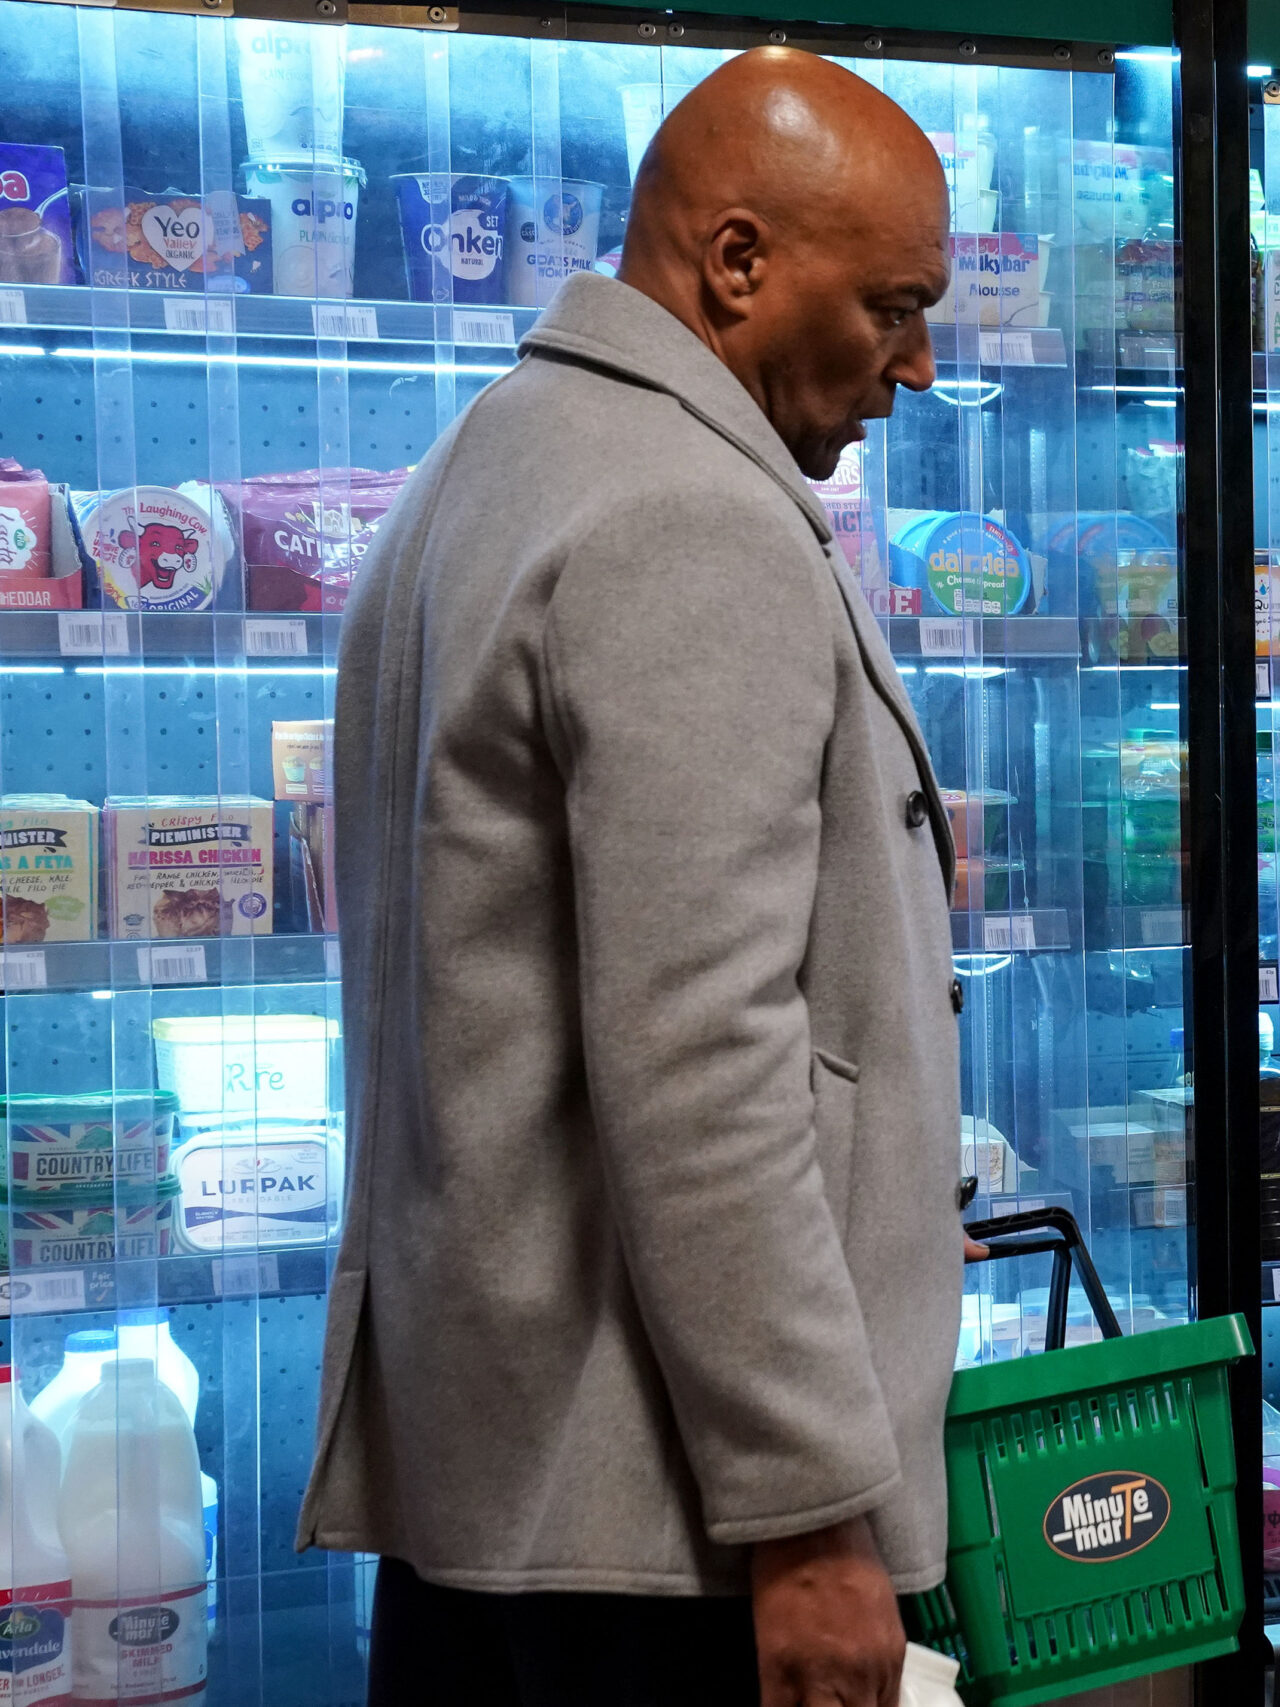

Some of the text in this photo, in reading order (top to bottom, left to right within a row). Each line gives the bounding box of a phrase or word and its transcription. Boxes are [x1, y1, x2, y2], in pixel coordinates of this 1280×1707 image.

[154, 216, 200, 239] Yeo
[486, 216, 499, 228] SET
[163, 237, 197, 250] Valley
[958, 254, 1030, 275] Milkybar
[146, 272, 188, 289] STYLE
[140, 502, 189, 525] Laughing
[188, 516, 208, 534] Cow
[151, 827, 242, 844] PIEMINISTER
[18, 855, 28, 869] A
[35, 854, 73, 869] FETA
[128, 850, 193, 866] HARISSA
[190, 879, 223, 887] CHICKPE
[36, 1152, 152, 1176] COUNTRY LIFE
[40, 1237, 155, 1263] COUNTRY LIFE
[3, 1621, 34, 1636] Arla
